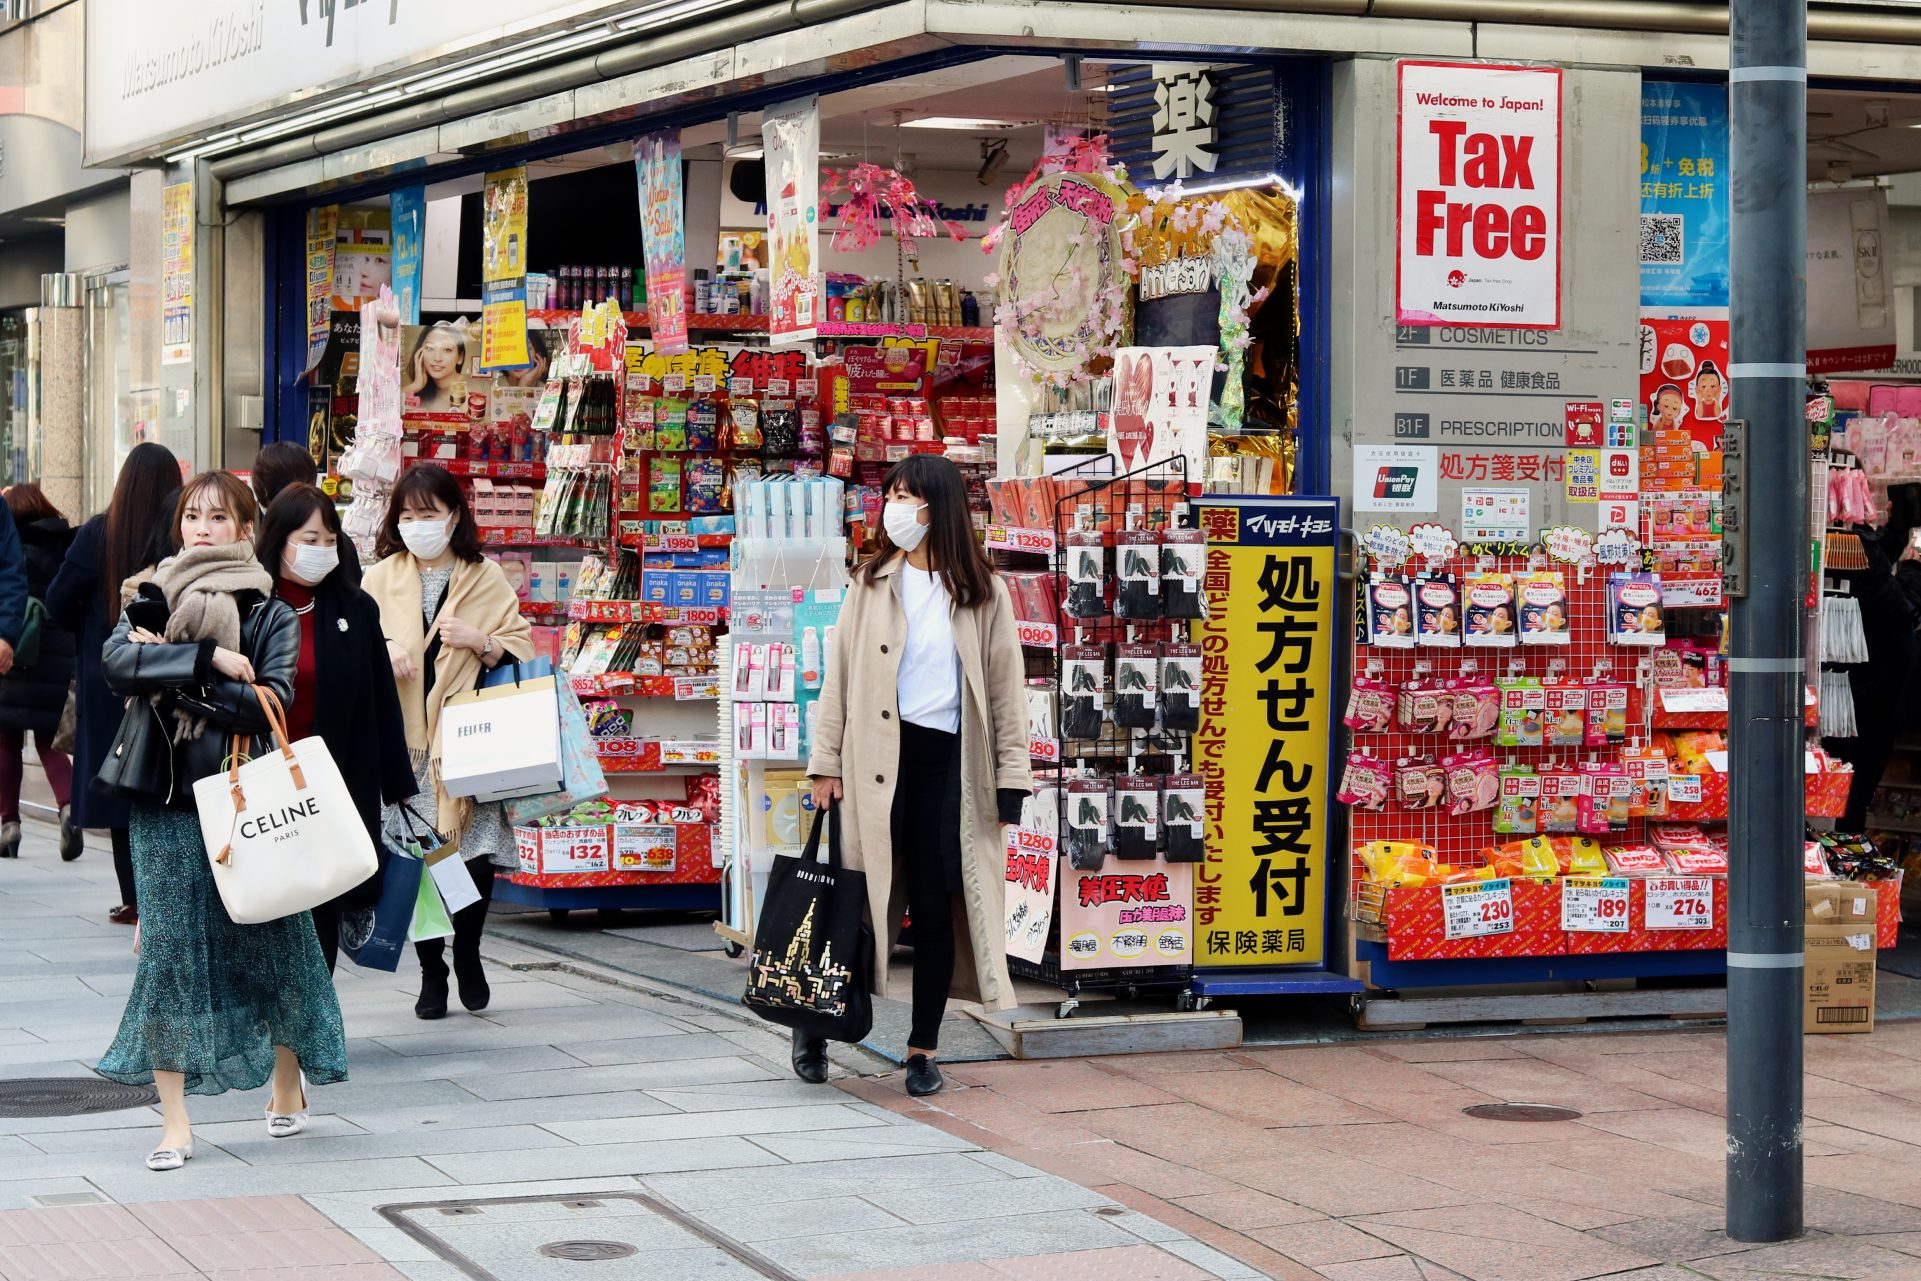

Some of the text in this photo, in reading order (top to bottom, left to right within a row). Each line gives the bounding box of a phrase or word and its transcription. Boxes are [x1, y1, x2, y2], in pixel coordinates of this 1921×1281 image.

[1416, 93, 1543, 113] Welcome to Japan!
[1152, 65, 1218, 179] 薬
[1429, 120, 1535, 189] Tax
[1679, 158, 1714, 176] 免税
[1416, 190, 1546, 260] Free
[1141, 254, 1212, 300] Anniversary
[1398, 326, 1548, 345] 2F COSMETICS
[1399, 369, 1560, 389] 1F 医薬品 健康食品
[1567, 404, 1587, 412] Wi-Fi
[1397, 418, 1563, 437] B1F PRESCRIPTION
[1440, 453, 1565, 481] 処方箋受付
[1573, 456, 1593, 464] 中央区
[1611, 459, 1627, 467] d払い
[1378, 474, 1415, 485] UnionPay
[1572, 475, 1594, 484] 商品券
[1568, 486, 1597, 498] 取扱店
[1202, 509, 1333, 541] 薬 マツモトキヨシ
[667, 538, 695, 548] 1980
[1016, 534, 1053, 548] 1280
[1373, 531, 1406, 547] 朝、のどの
[1472, 542, 1530, 557] めぐりズム
[1600, 543, 1635, 560] 風邪対策に
[1695, 587, 1717, 596] 462
[687, 610, 715, 621] 1800
[1017, 627, 1053, 642] 1080
[457, 722, 492, 737] FEILER
[1195, 550, 1232, 925] 全国どこの処方せんでも受付いたします
[1250, 555, 1320, 917] 処方せん受付
[596, 740, 638, 753] 108
[240, 797, 320, 839] CELINE
[274, 829, 300, 843] PARIS
[545, 828, 605, 839] 当店のおすすめ品
[1018, 831, 1053, 851] 1280
[569, 845, 603, 860] 132
[648, 848, 674, 860] 638
[1660, 881, 1708, 890] お買い得品!!
[1481, 900, 1510, 922] 230
[1597, 899, 1626, 917] 189
[1673, 899, 1706, 915] 276
[1494, 922, 1510, 930] 253
[1206, 929, 1304, 955] 保険薬局
